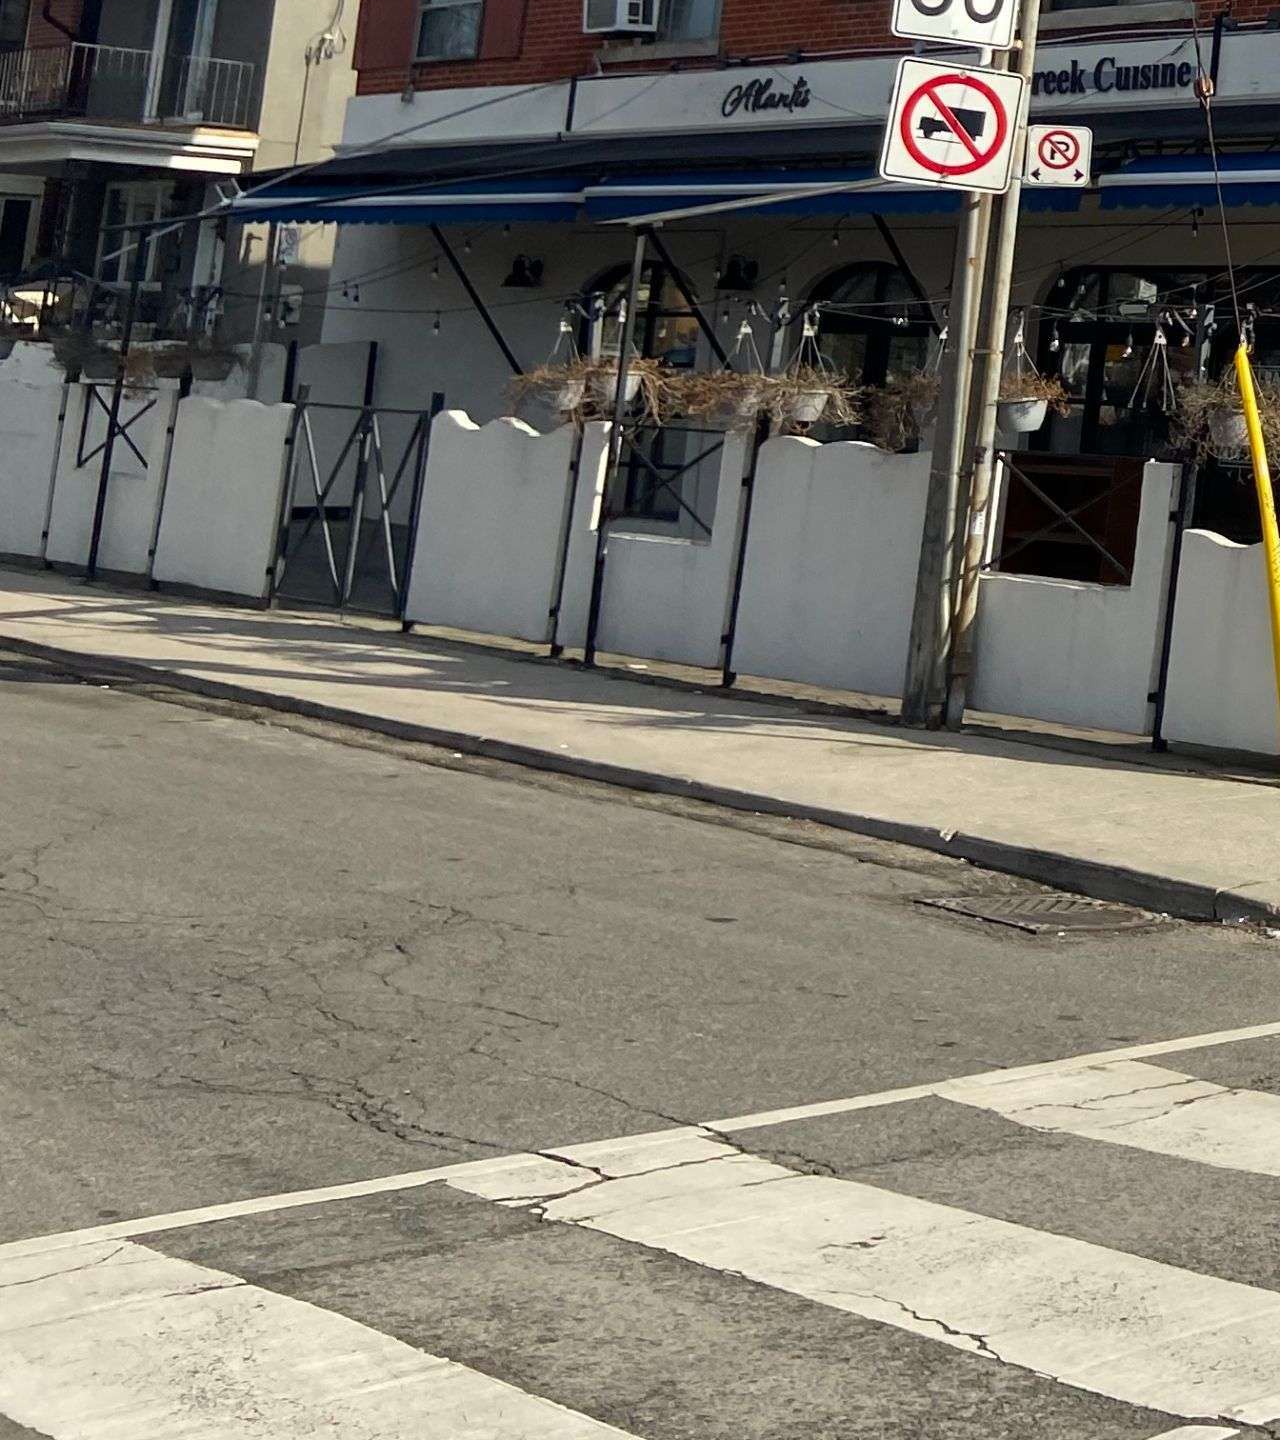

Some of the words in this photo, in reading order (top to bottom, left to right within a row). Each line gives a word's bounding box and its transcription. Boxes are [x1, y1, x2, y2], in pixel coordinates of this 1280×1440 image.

[722, 75, 811, 118] Atlantis
[1032, 59, 1087, 96] reek
[1093, 56, 1193, 93] Cuisine
